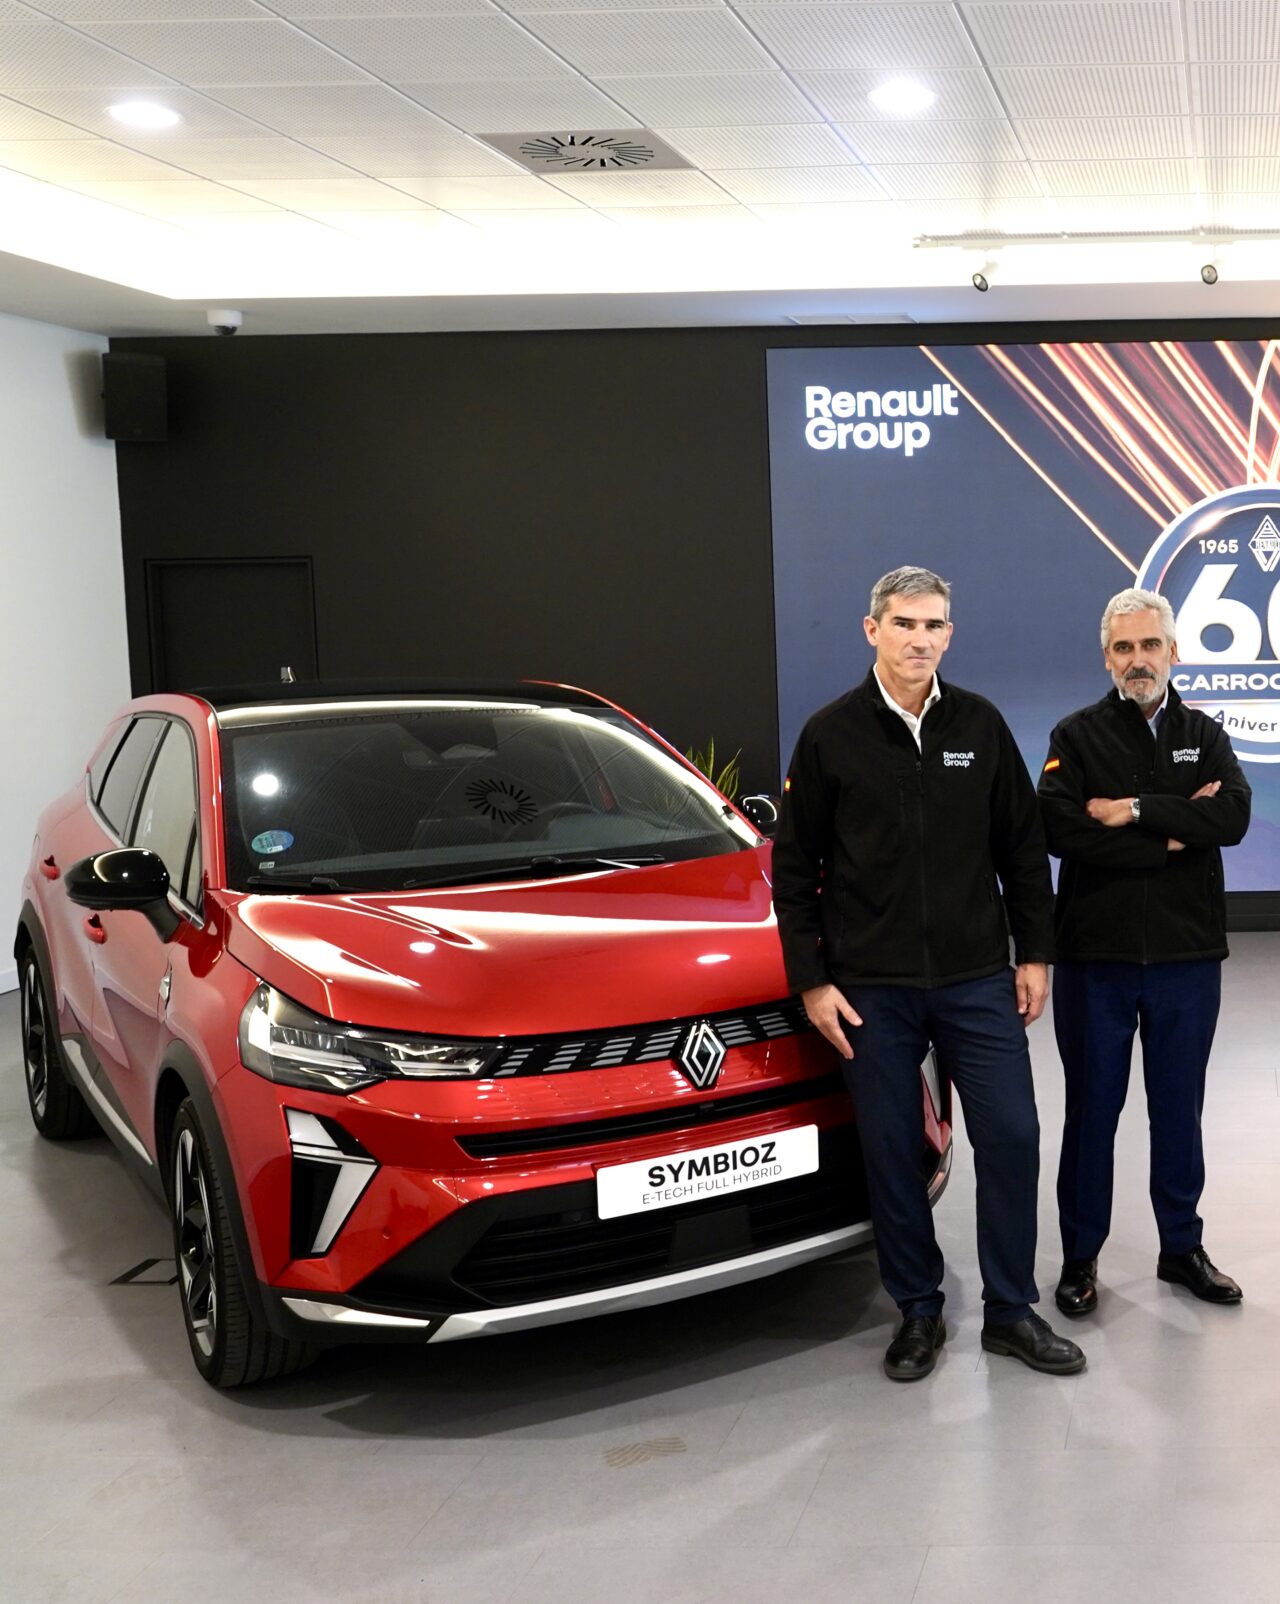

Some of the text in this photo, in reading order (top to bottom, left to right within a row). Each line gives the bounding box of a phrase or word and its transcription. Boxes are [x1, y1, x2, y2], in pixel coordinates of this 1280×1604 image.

[805, 383, 959, 418] Renault
[805, 416, 931, 457] Group
[1199, 539, 1239, 554] 1965
[943, 751, 975, 760] Renault
[943, 758, 970, 768] Group
[648, 1141, 777, 1187] SYMBIOZ
[642, 1164, 782, 1205] E-TECH FULL HYBRID
